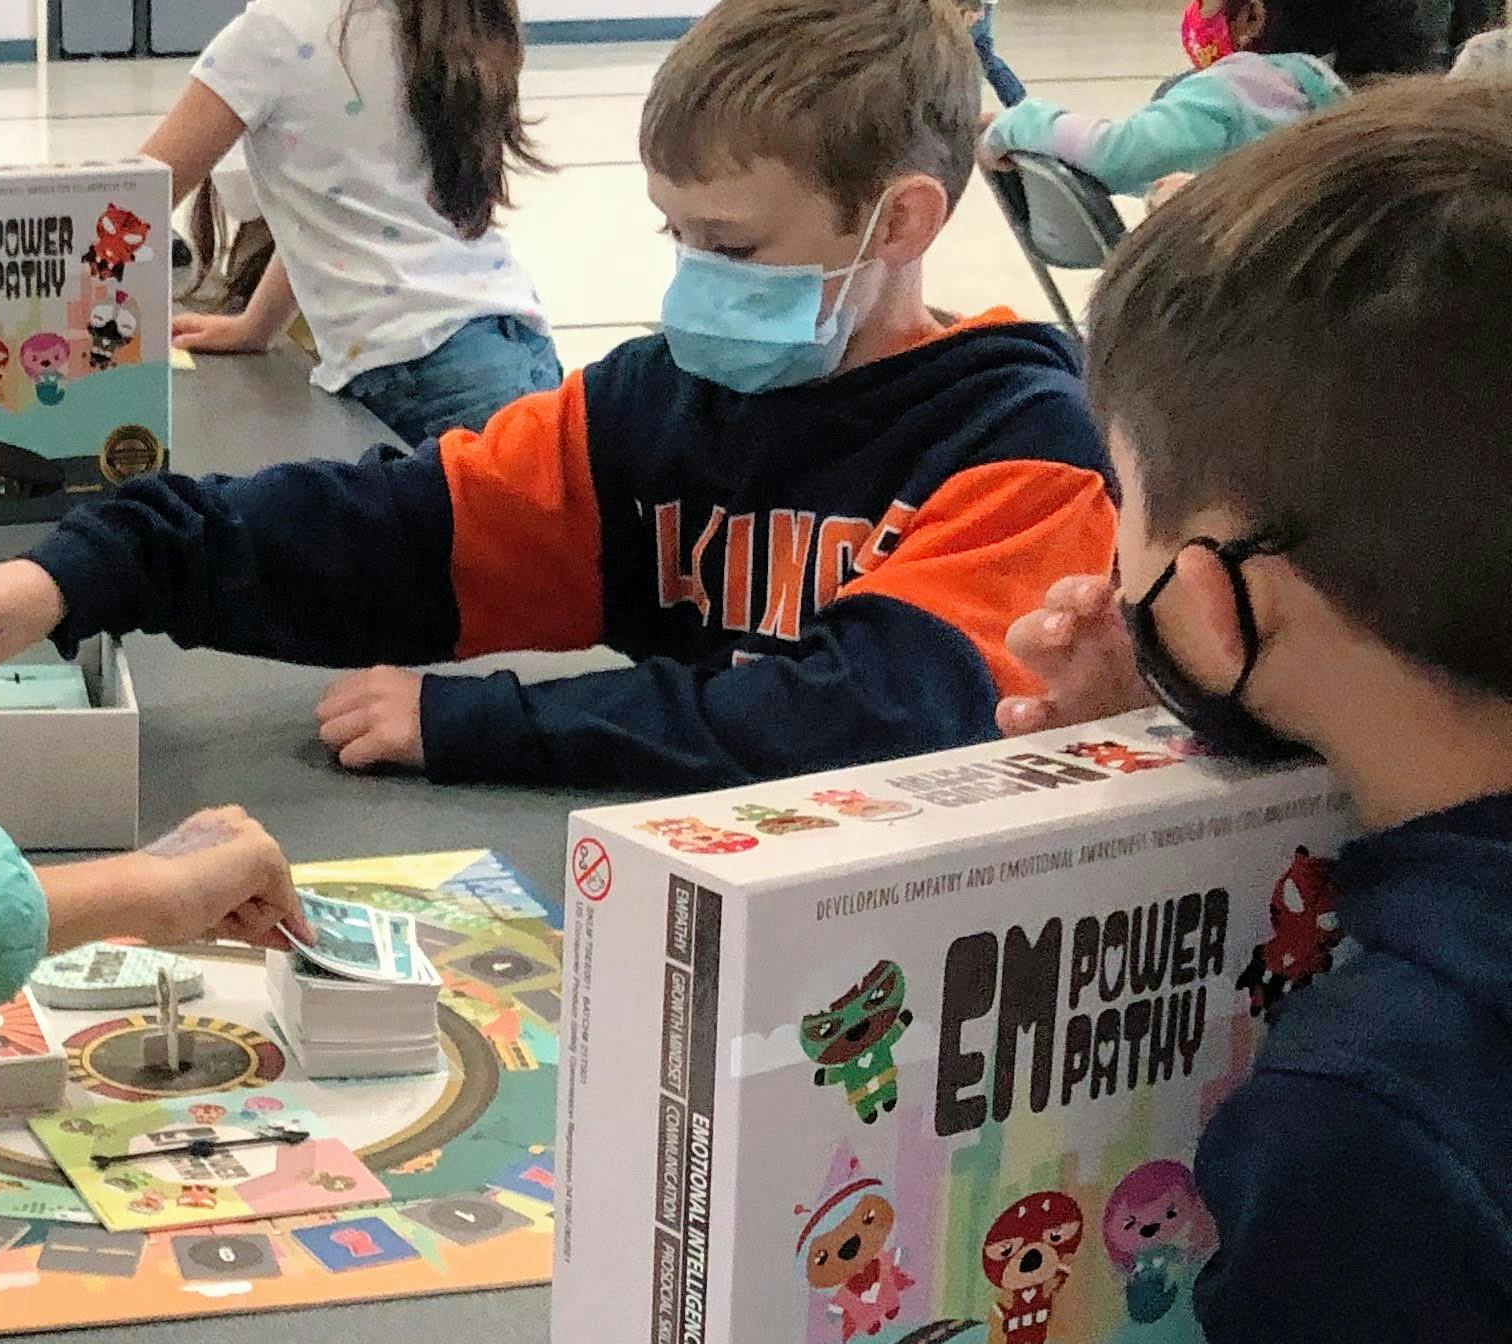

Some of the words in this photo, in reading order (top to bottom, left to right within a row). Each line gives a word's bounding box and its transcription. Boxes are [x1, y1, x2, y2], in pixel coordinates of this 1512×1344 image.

[673, 887, 690, 952] EMPATHY
[816, 883, 899, 921] DEVELOPING
[904, 871, 963, 902] EMPATHY
[966, 866, 995, 888] AND
[999, 848, 1073, 882] EMOTIONAL
[670, 971, 687, 1030] GROWTH
[935, 917, 1063, 1137] EM
[1069, 887, 1229, 1010] POWER
[667, 1031, 685, 1090] MINDSET
[1061, 986, 1206, 1106] PATHY
[663, 1104, 681, 1224] COMMUNICATION
[688, 1113, 710, 1224] EMOTIONAL
[659, 1241, 675, 1315] PROSOCIAL
